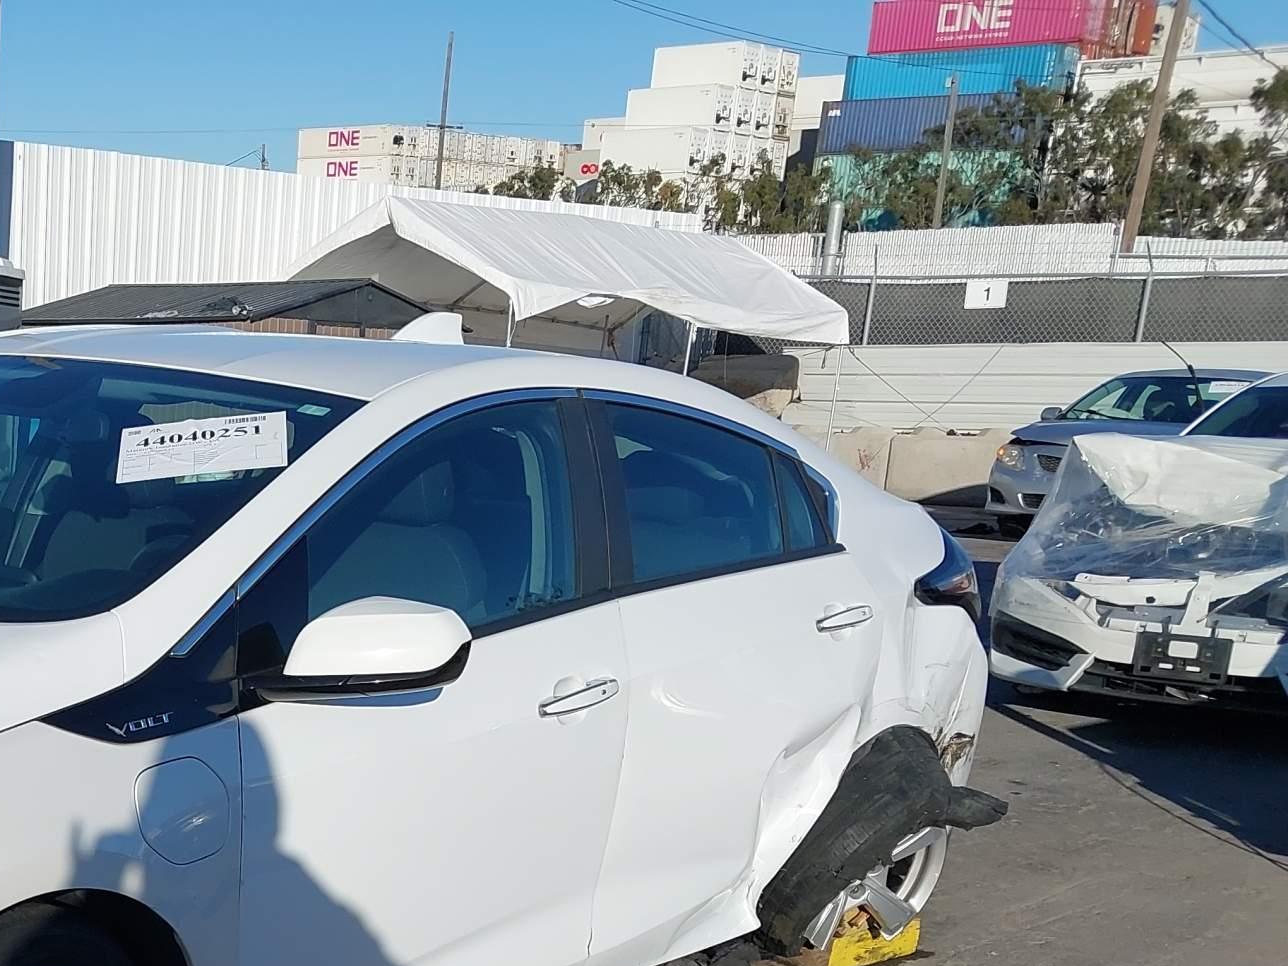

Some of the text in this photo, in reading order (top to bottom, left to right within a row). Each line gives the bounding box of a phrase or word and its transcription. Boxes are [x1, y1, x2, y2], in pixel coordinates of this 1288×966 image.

[937, 0, 1013, 33] ONE
[328, 130, 360, 147] ONE
[327, 161, 358, 177] ONE
[984, 287, 991, 301] 1
[136, 425, 262, 447] 44040251
[105, 712, 174, 737] VOLT
